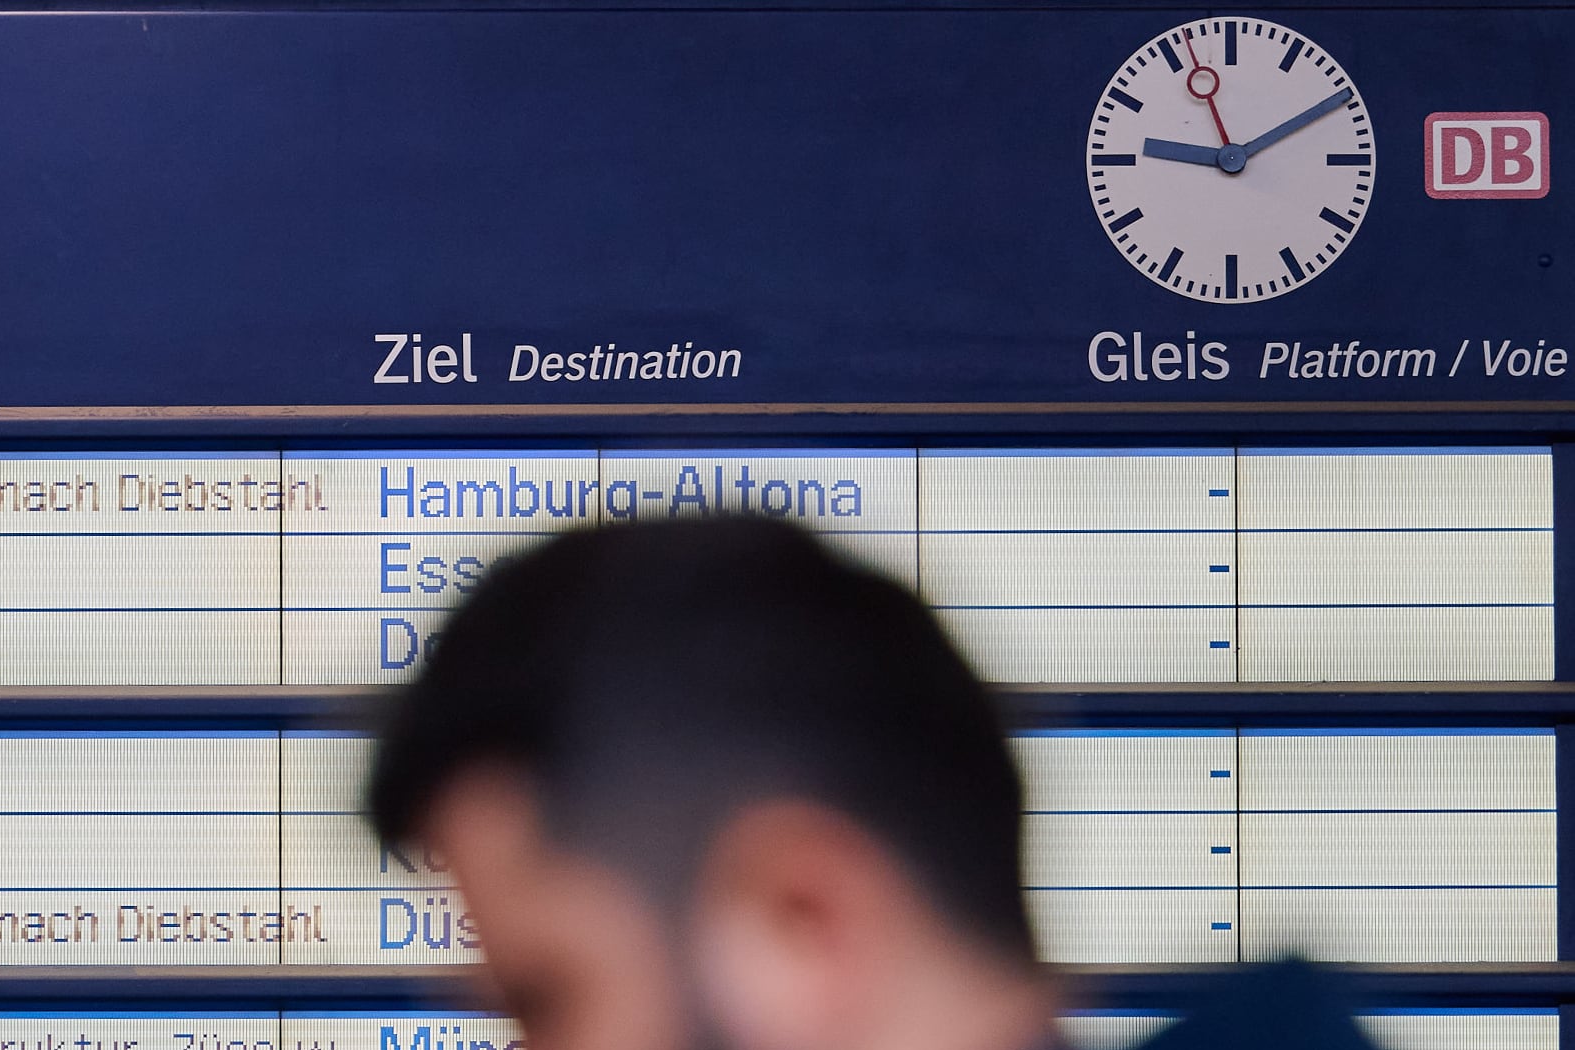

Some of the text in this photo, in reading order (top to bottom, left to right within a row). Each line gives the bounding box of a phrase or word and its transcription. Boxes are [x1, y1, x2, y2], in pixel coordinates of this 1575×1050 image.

[1441, 127, 1535, 185] DB
[374, 332, 743, 384] Ziel Destination
[1087, 330, 1230, 383] Gleis
[1259, 340, 1436, 379] Platform
[1482, 340, 1569, 379] Voie
[119, 474, 329, 512] Diebstahl
[380, 465, 862, 520] Hamburg-Altona
[380, 542, 499, 594] Ess
[118, 905, 328, 942] Diebstahl
[380, 898, 481, 949] Düs
